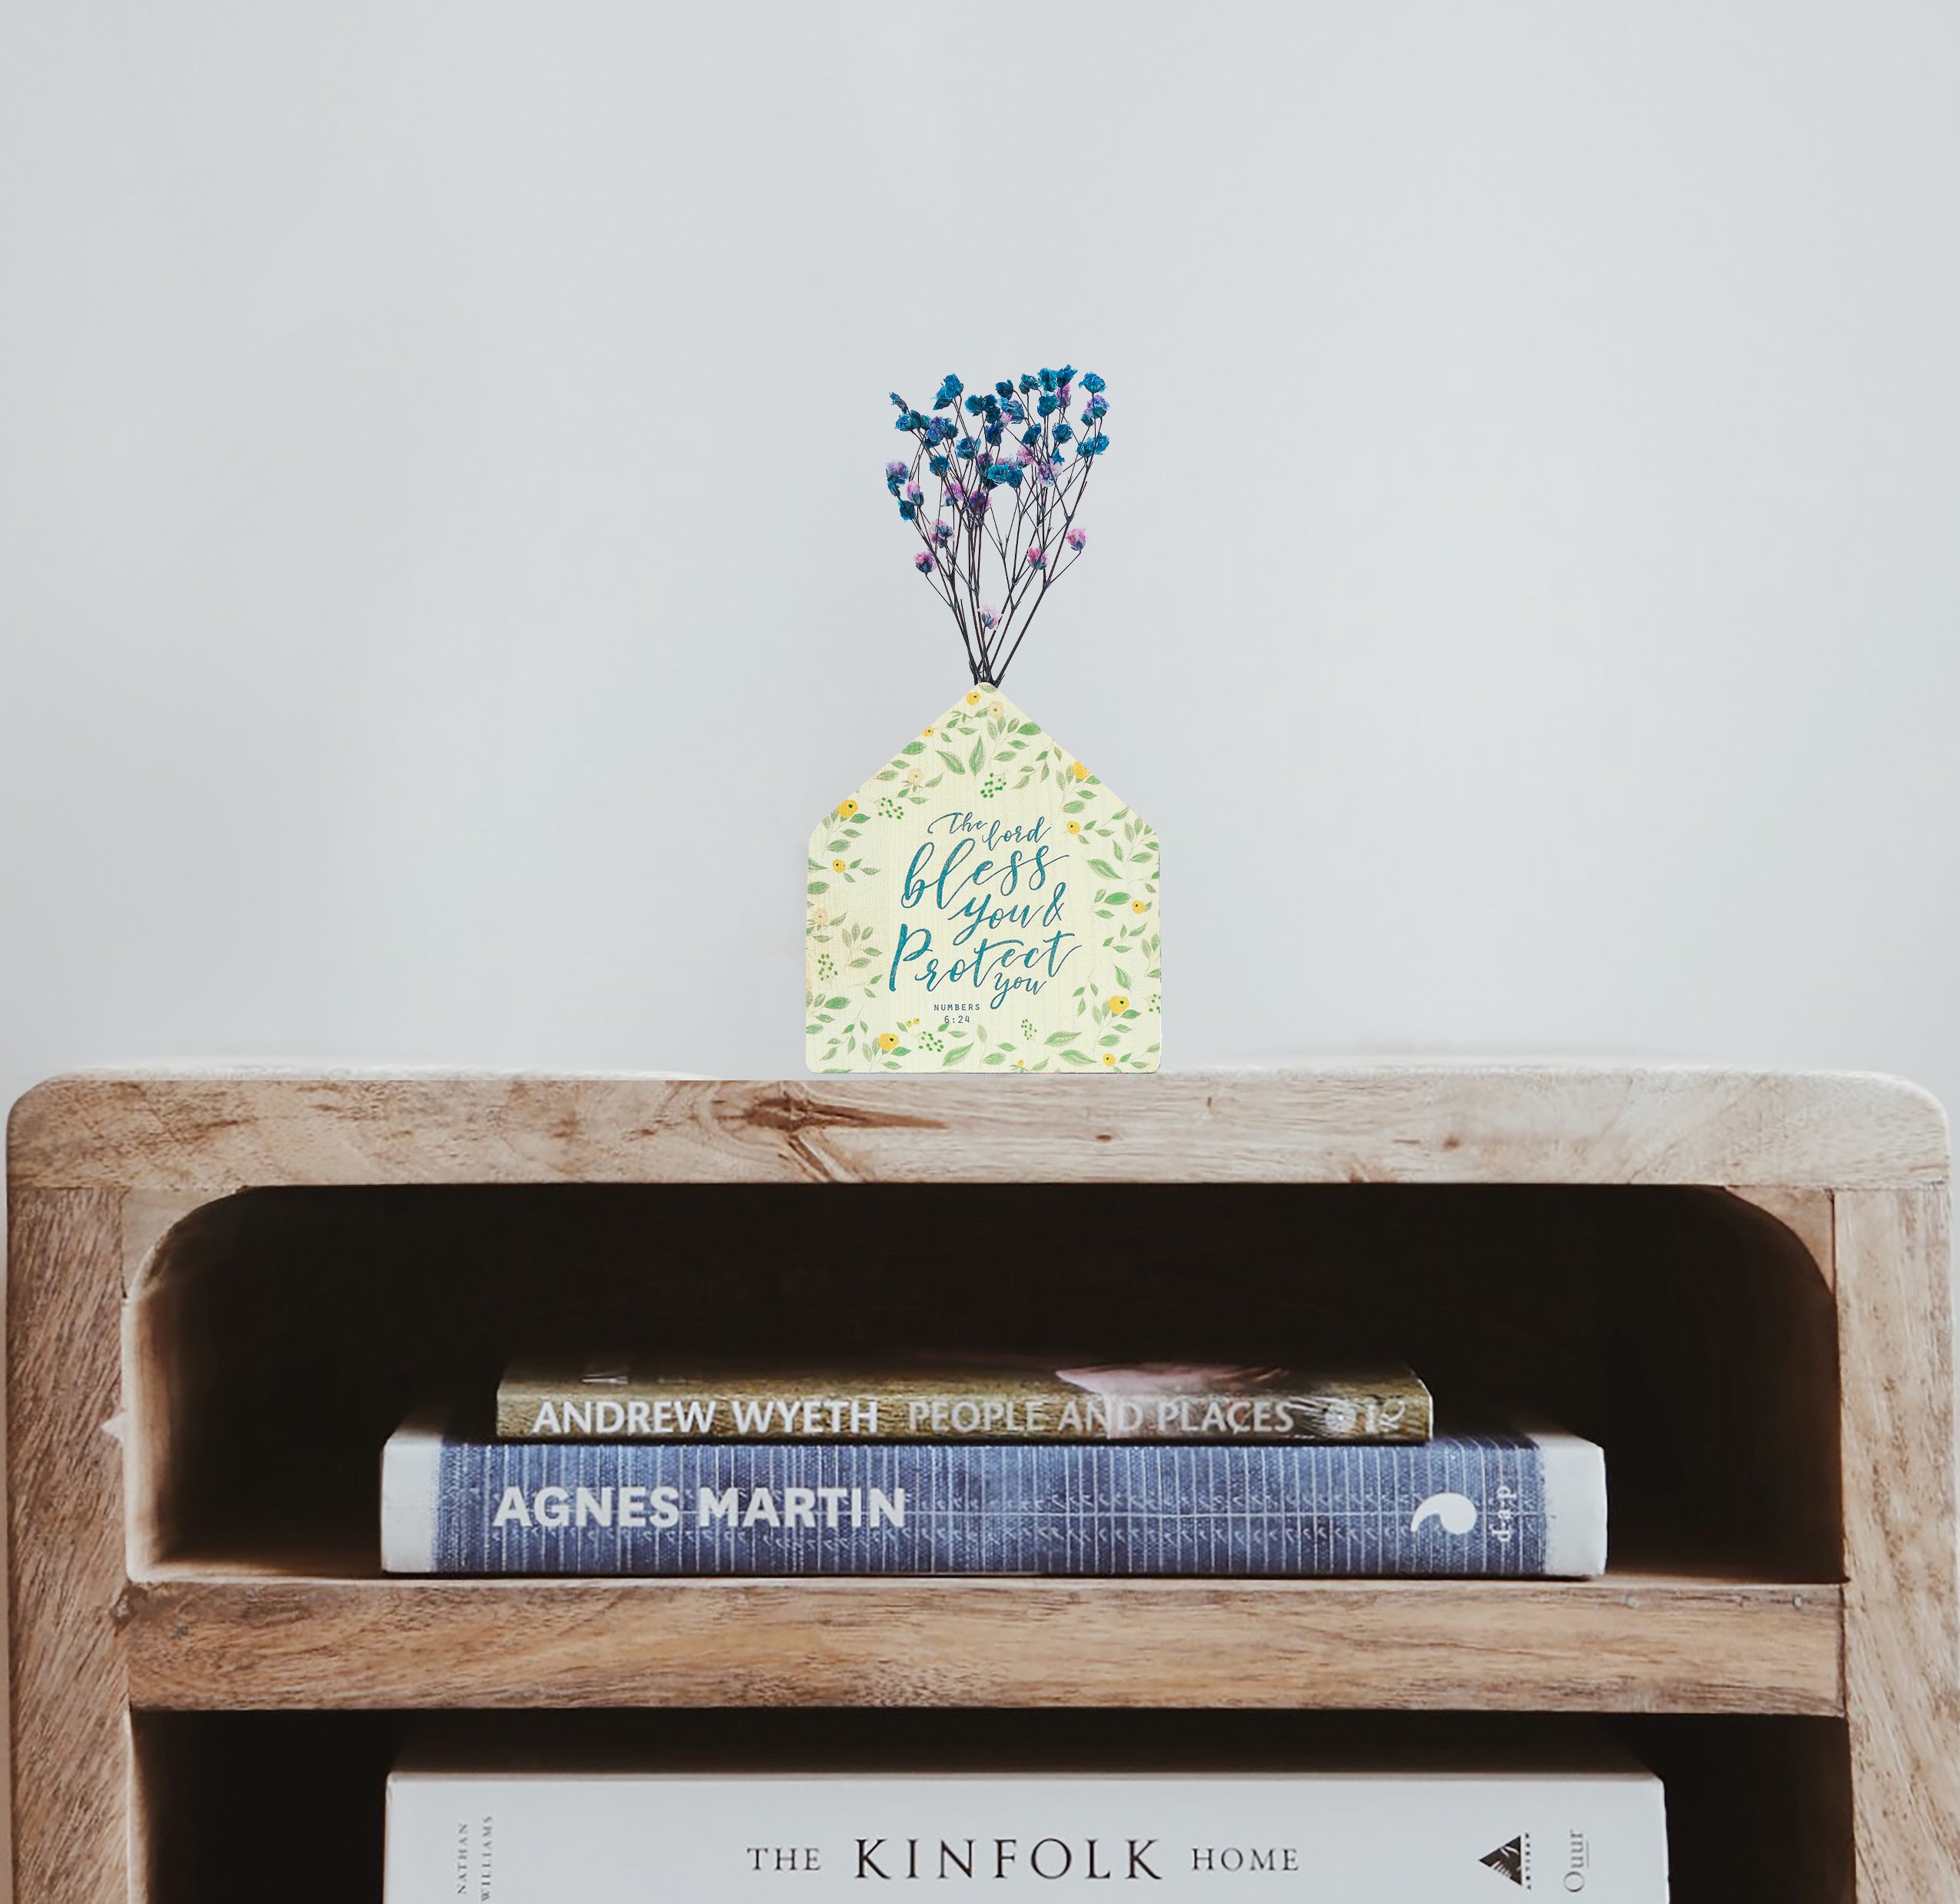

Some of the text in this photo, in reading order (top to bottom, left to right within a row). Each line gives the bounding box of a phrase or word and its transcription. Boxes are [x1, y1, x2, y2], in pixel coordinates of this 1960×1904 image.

[927, 811, 1051, 851] The lord
[900, 837, 1070, 910] bless
[947, 881, 1067, 946] you &
[889, 923, 1082, 992] Protect
[933, 1003, 981, 1012] NUMBERS
[990, 971, 1047, 1010] you
[943, 1014, 971, 1024] 6:24
[531, 1400, 1295, 1434] ANDREW WYETH PEOPLE AND PLACES
[492, 1485, 906, 1529] AGNES MARTIN
[457, 1822, 469, 1895] NATHAN
[481, 1815, 494, 1902] WILLIAMS
[747, 1838, 1299, 1880] THE KINFOLK HOME
